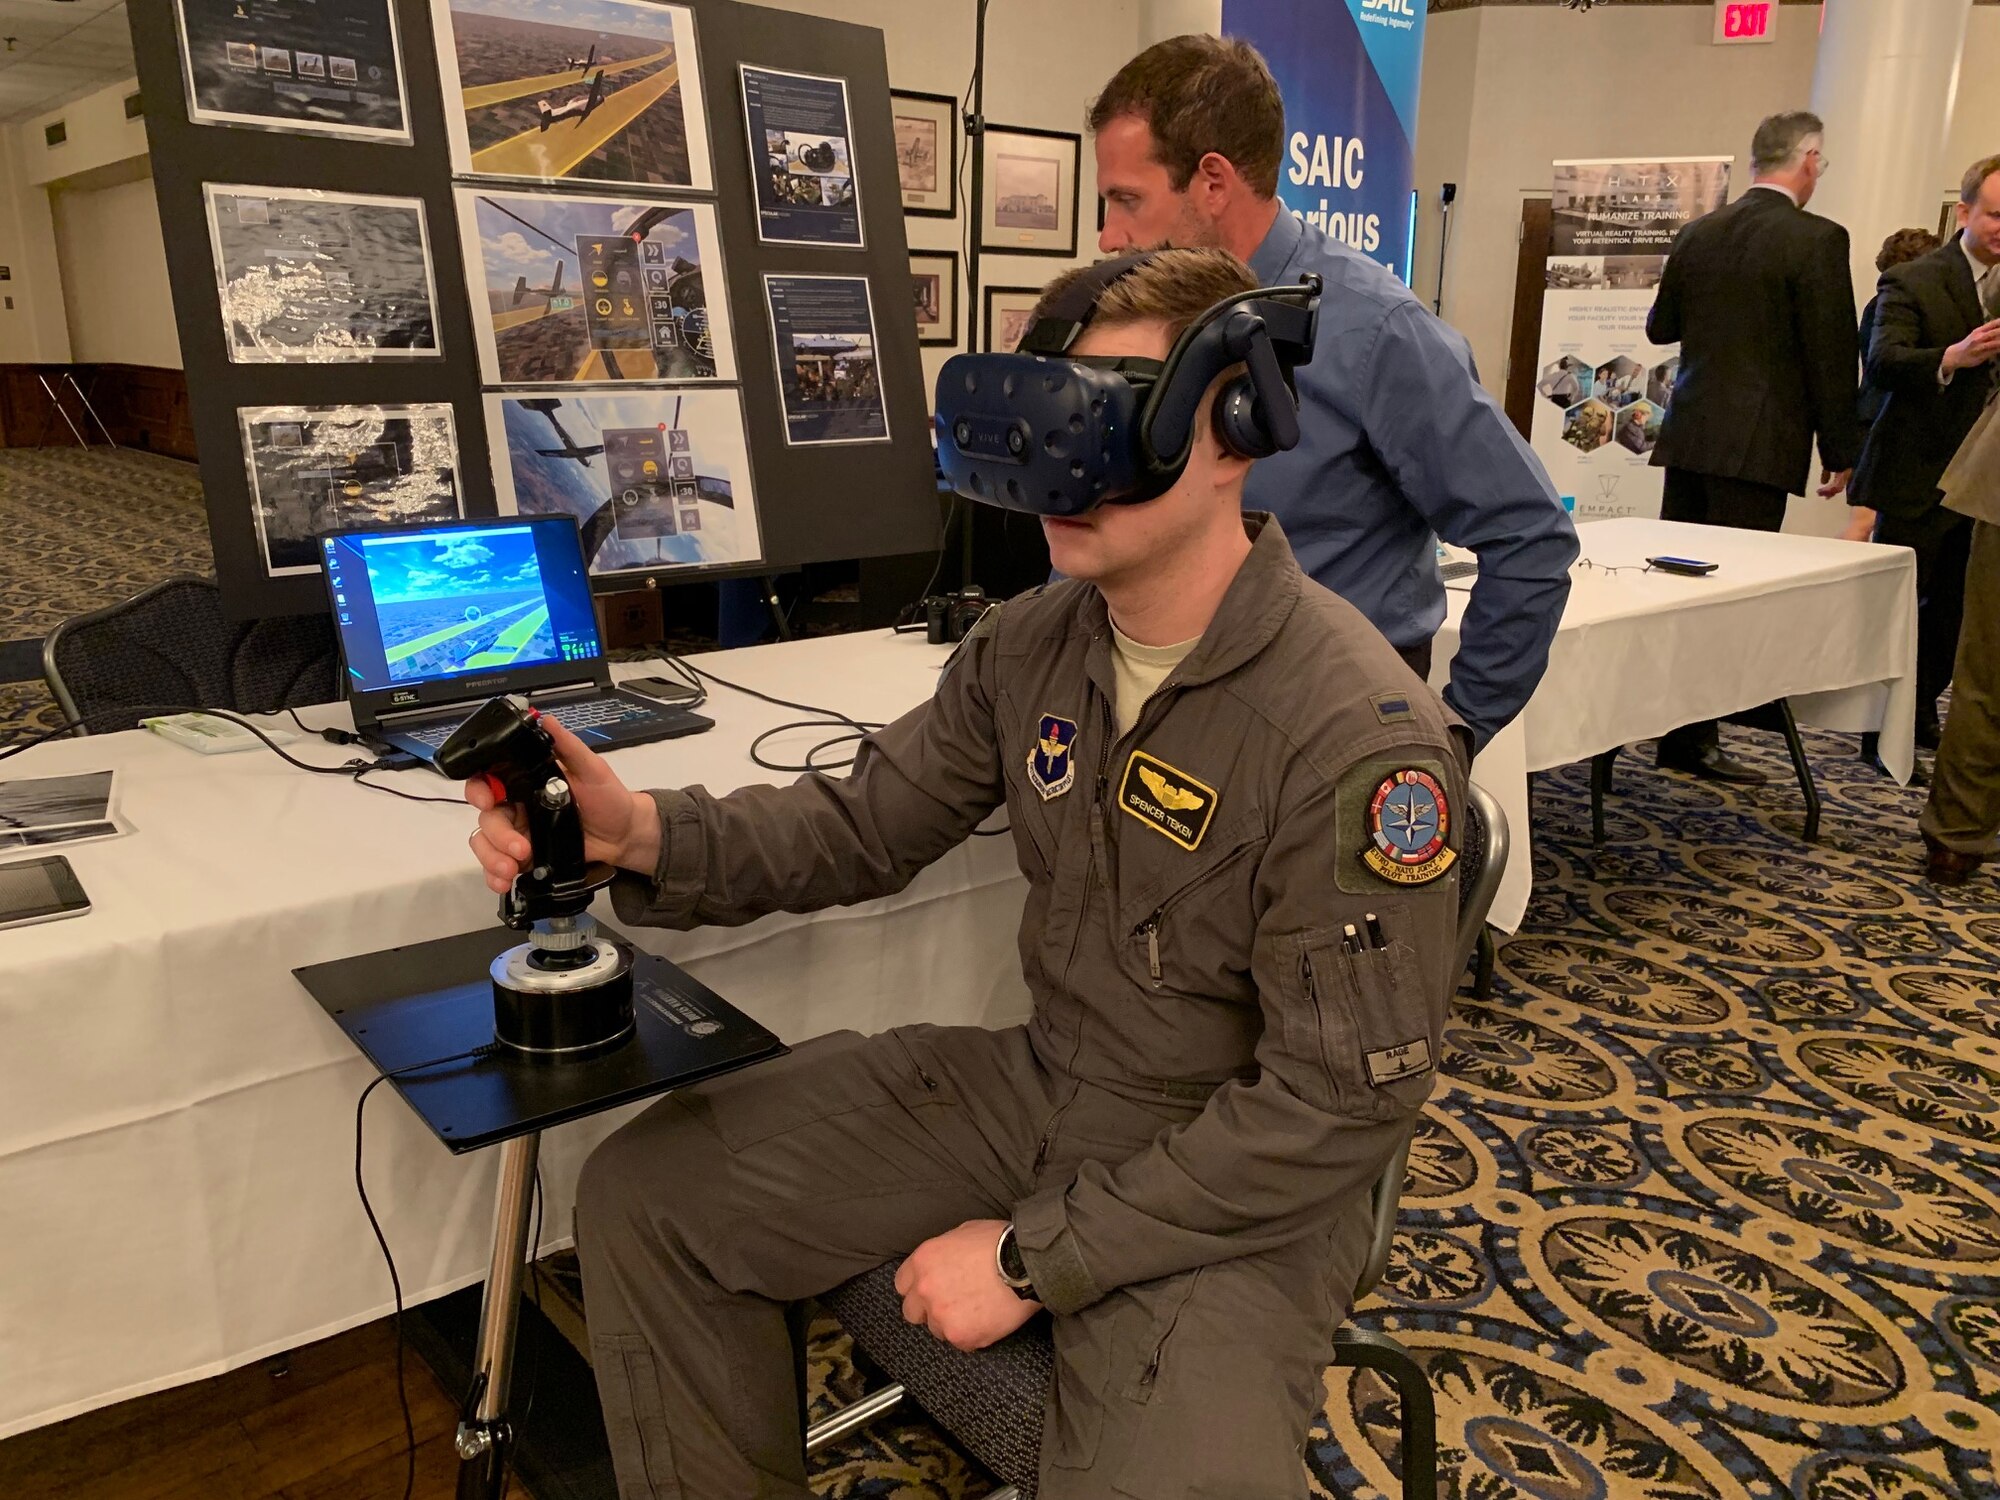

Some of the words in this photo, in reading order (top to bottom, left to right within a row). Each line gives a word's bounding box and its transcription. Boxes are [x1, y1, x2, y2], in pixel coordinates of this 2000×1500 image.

[1724, 3, 1770, 38] EXIT
[1288, 131, 1364, 190] SAIC
[1621, 194, 1662, 203] LABS
[1588, 211, 1639, 221] HUMANIZE
[1642, 210, 1691, 220] TRAINING
[978, 431, 1000, 444] VIVE
[1129, 794, 1165, 822] SPENCER
[1369, 847, 1390, 867] EURO
[1394, 866, 1415, 875] NATO
[1417, 860, 1437, 873] JOINT
[1438, 848, 1449, 862] JET
[1378, 866, 1402, 880] PILOT
[1406, 865, 1442, 881] TRAINING
[1385, 1046, 1410, 1059] RAGE
